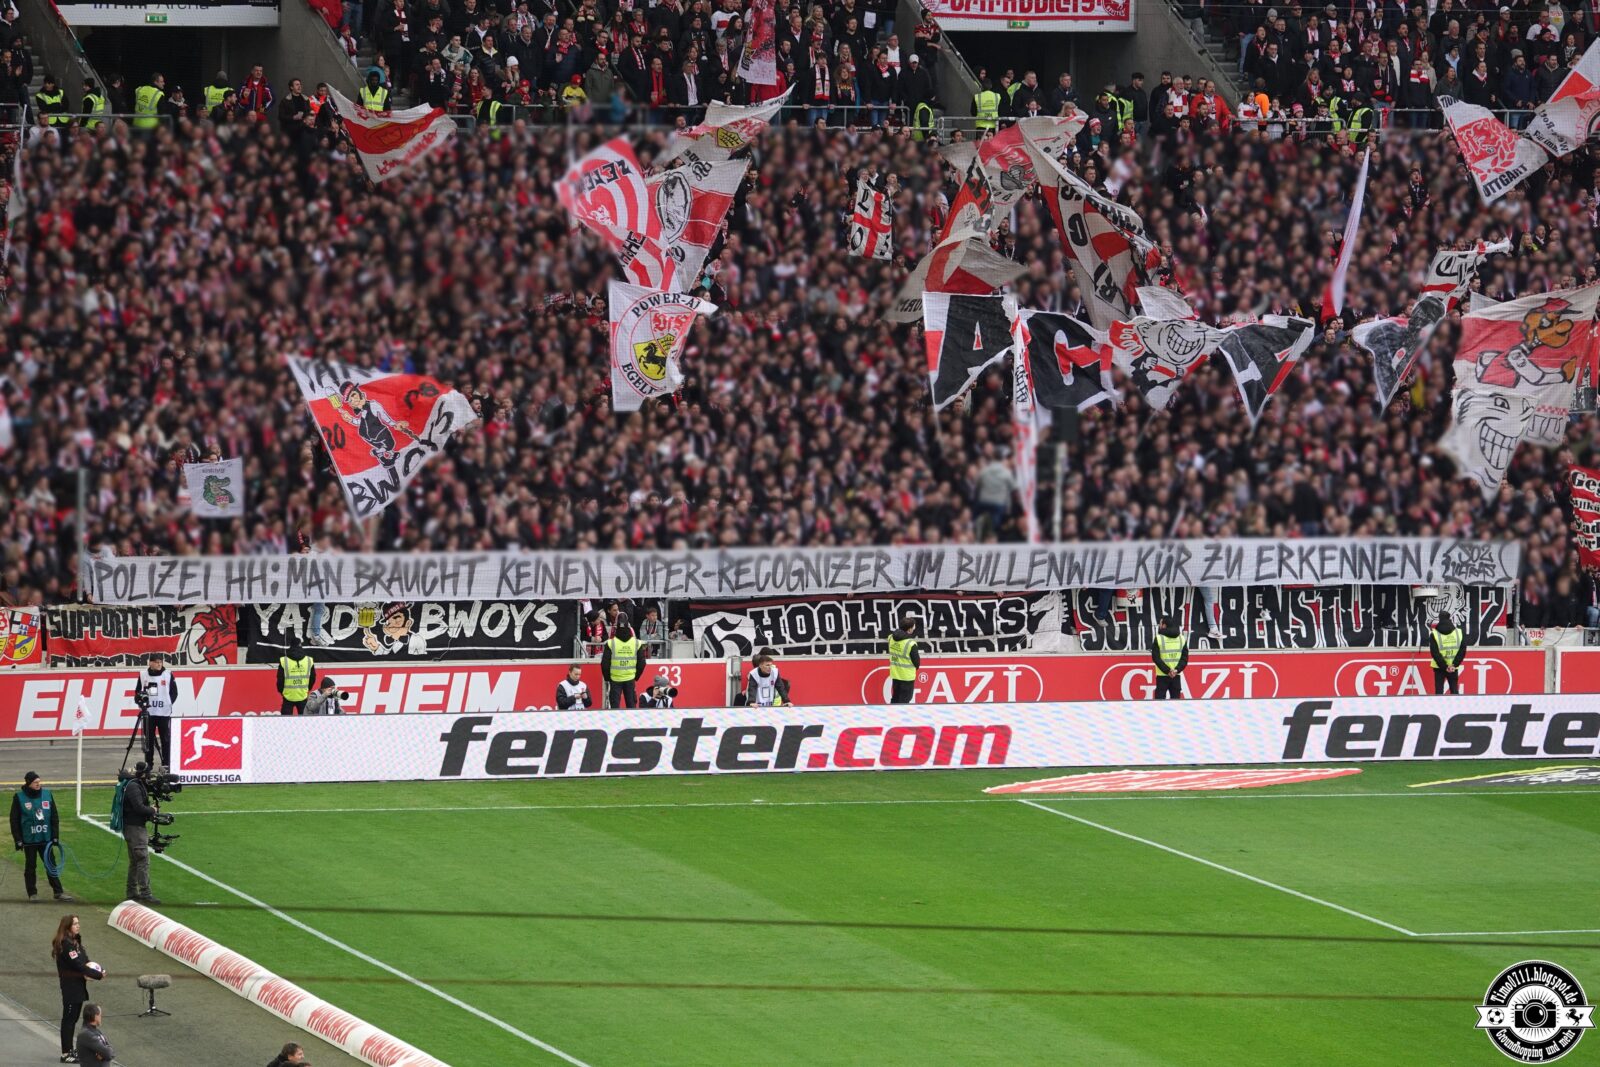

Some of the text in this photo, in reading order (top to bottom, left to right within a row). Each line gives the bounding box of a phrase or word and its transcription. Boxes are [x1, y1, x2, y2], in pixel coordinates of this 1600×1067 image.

[94, 559, 211, 602] POLIZEI
[286, 557, 344, 600] MAN
[352, 555, 488, 597] BRAUCHT
[496, 555, 603, 597] KEINEN
[614, 549, 895, 594] SUPER-RECOGNIZER
[903, 548, 945, 588] UM
[950, 543, 1192, 588] BULLENWILLKÜR
[1200, 543, 1244, 581] ZU
[255, 602, 358, 647] YARD
[418, 601, 559, 642] BWOYS
[747, 597, 1029, 647] HOOLIGANS
[322, 671, 521, 715] EHEIM
[658, 666, 682, 687] 33
[15, 676, 226, 731] EHEM
[439, 716, 1012, 777] fenster.com
[179, 773, 242, 785] BUNDESLIGA
